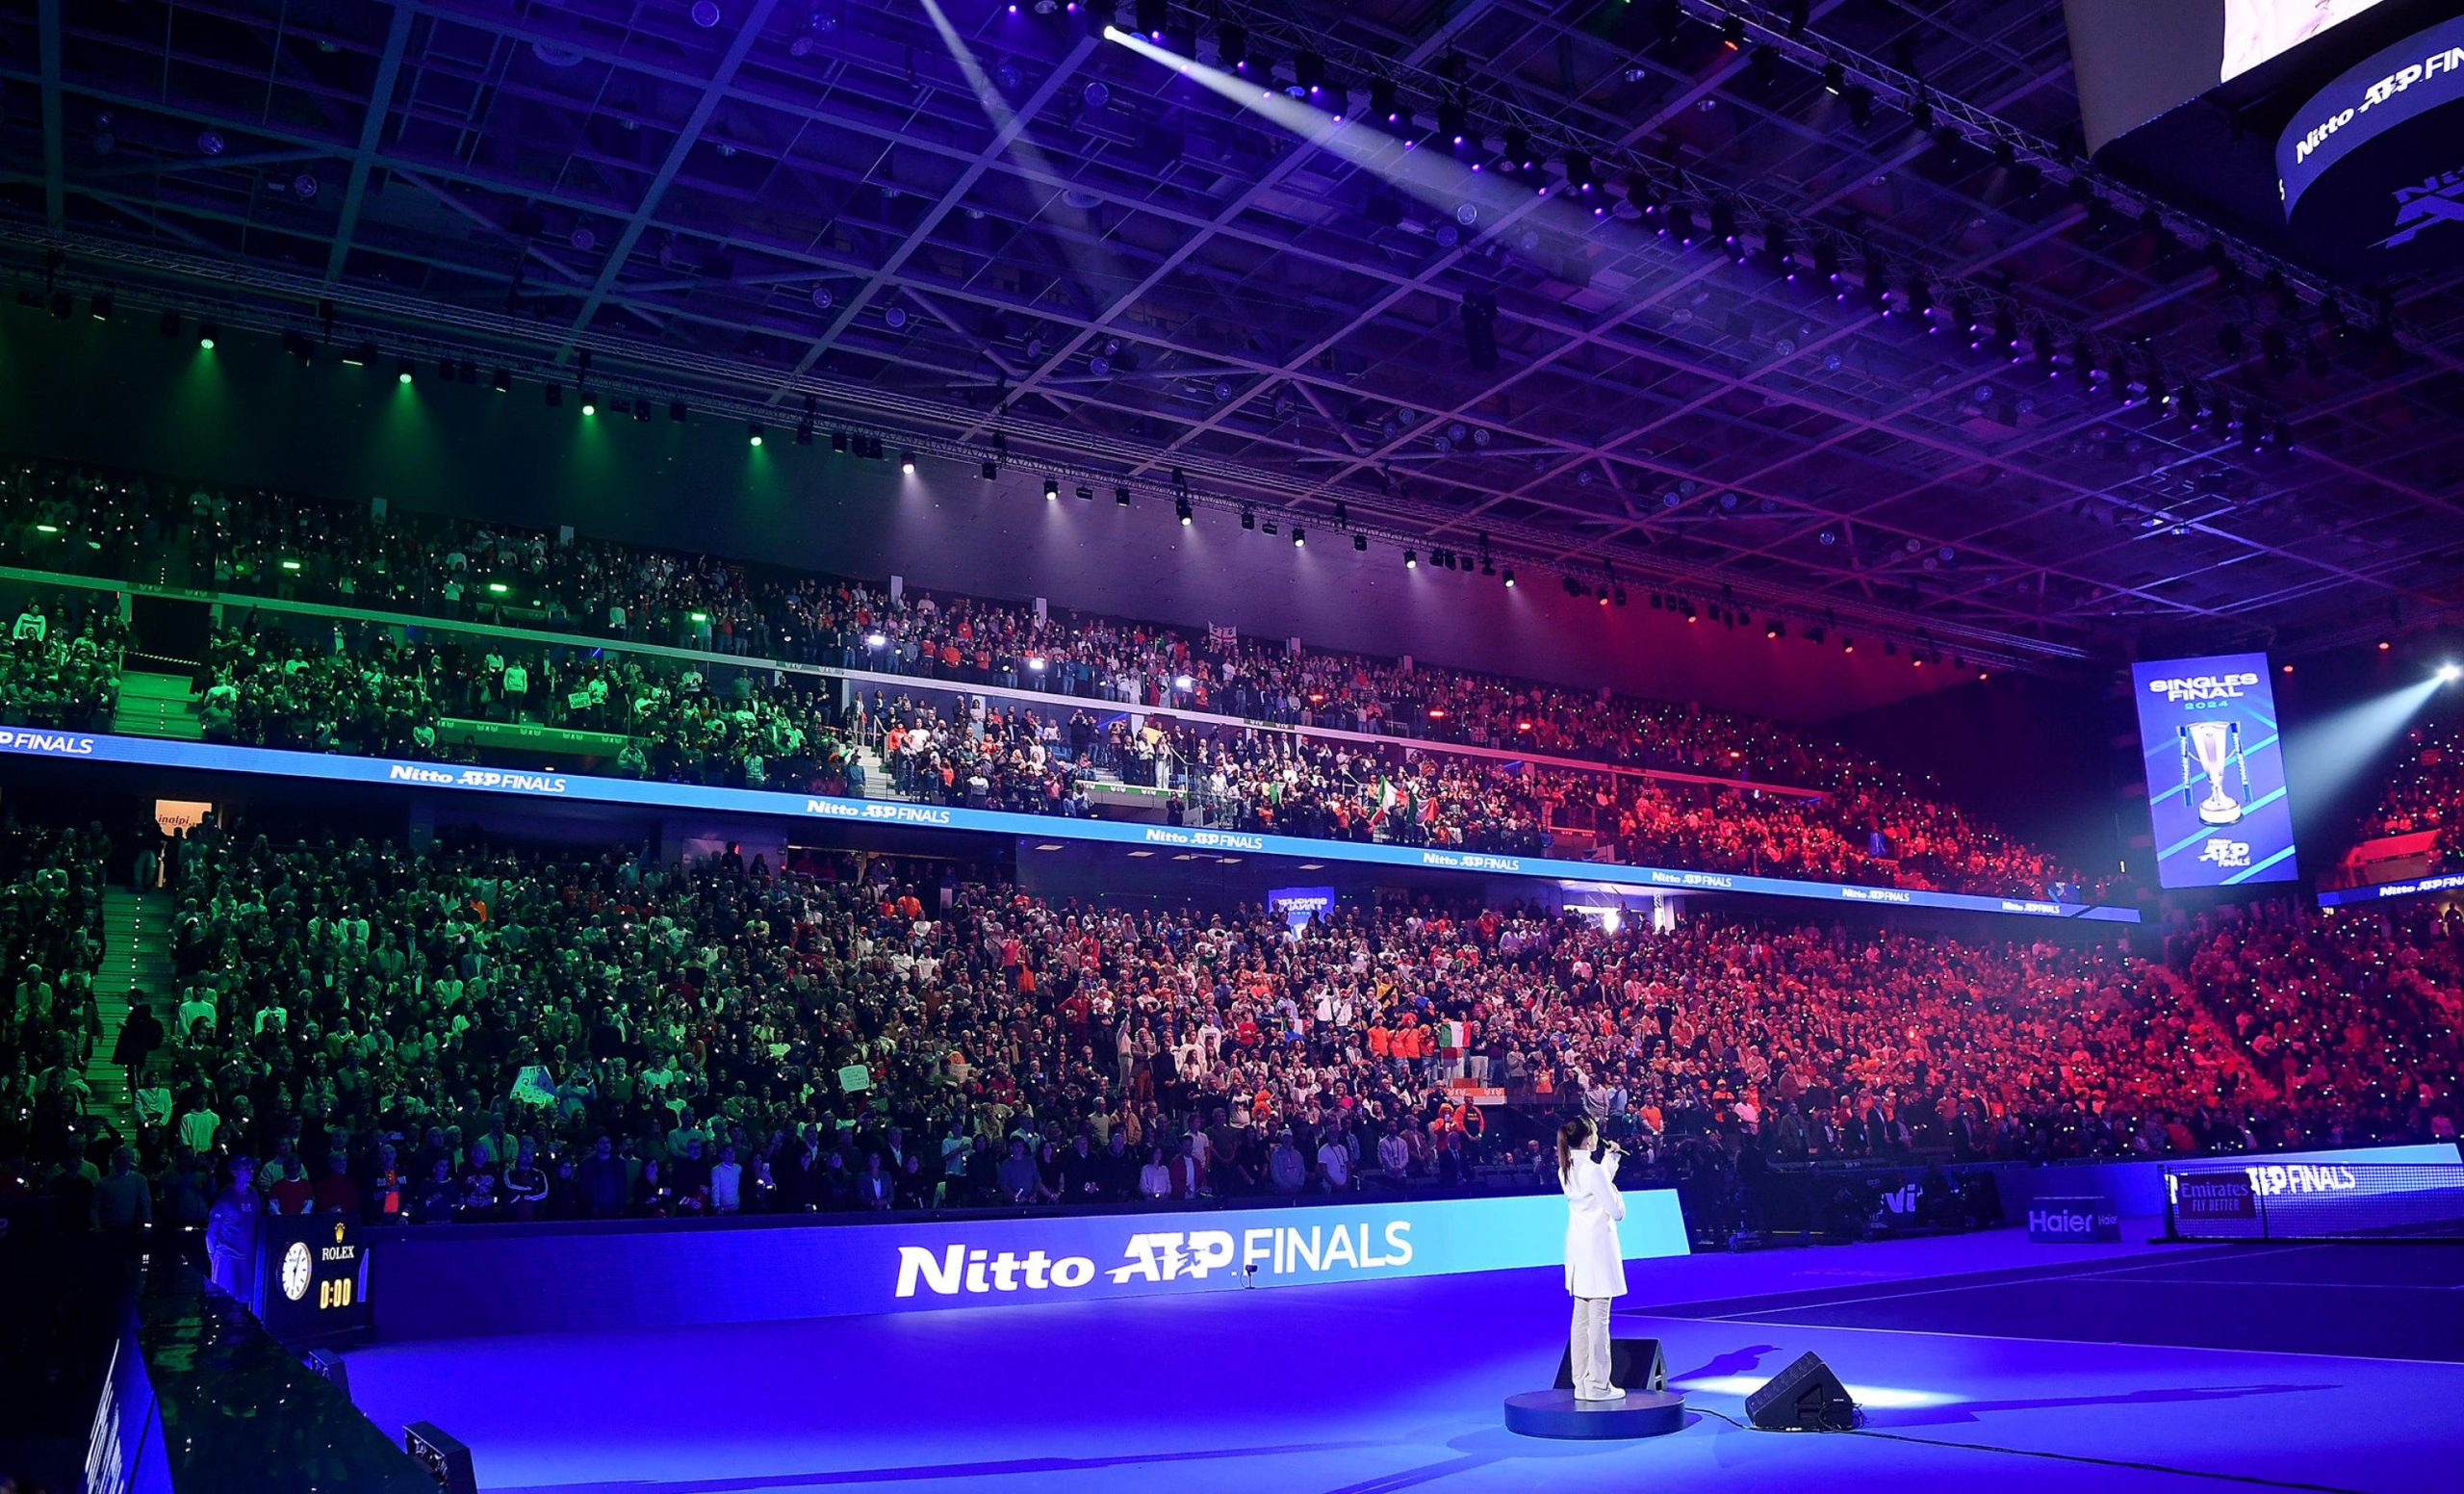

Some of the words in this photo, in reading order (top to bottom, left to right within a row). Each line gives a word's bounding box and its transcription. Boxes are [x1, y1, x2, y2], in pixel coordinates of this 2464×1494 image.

[2297, 108, 2355, 165] Nitto
[2357, 64, 2423, 114] ATP
[2148, 673, 2259, 692] SINGLES
[2168, 686, 2245, 702] FINAL
[2184, 700, 2229, 710] 2024
[13, 733, 94, 754] FINALS
[390, 764, 453, 784] Nitto
[456, 770, 500, 786] ATP
[501, 774, 566, 792] FINALS
[807, 800, 859, 816] Nitto
[861, 805, 896, 818] ATP
[897, 808, 950, 824] FINALS
[1145, 829, 1188, 843] Nitto
[1191, 832, 1219, 844] ATP
[1219, 835, 1263, 849] FINALS
[1423, 852, 1458, 865] Nitto
[1459, 856, 1483, 867] ATP
[1483, 857, 1520, 870] FINALS
[2197, 842, 2249, 863] ATP
[1652, 871, 1681, 884] Nitto
[1682, 874, 1703, 885] ATP
[1703, 875, 1732, 888] FINALS
[2379, 886, 2416, 896] Nitto
[2417, 879, 2442, 891] ATP
[1842, 888, 1867, 899] Nitto
[2180, 1181, 2248, 1198] Emirates
[2246, 1165, 2287, 1196] TP
[2287, 1164, 2356, 1194] FINALS
[2193, 1198, 2206, 1211] FLY
[2209, 1198, 2240, 1211] BETTER
[2029, 1209, 2092, 1232] Haier
[321, 1246, 355, 1261] ROLEX
[894, 1244, 1095, 1299] Nitto
[1104, 1229, 1234, 1285] ATP
[1244, 1220, 1412, 1277] FINALS
[320, 1277, 351, 1309] 0:00
